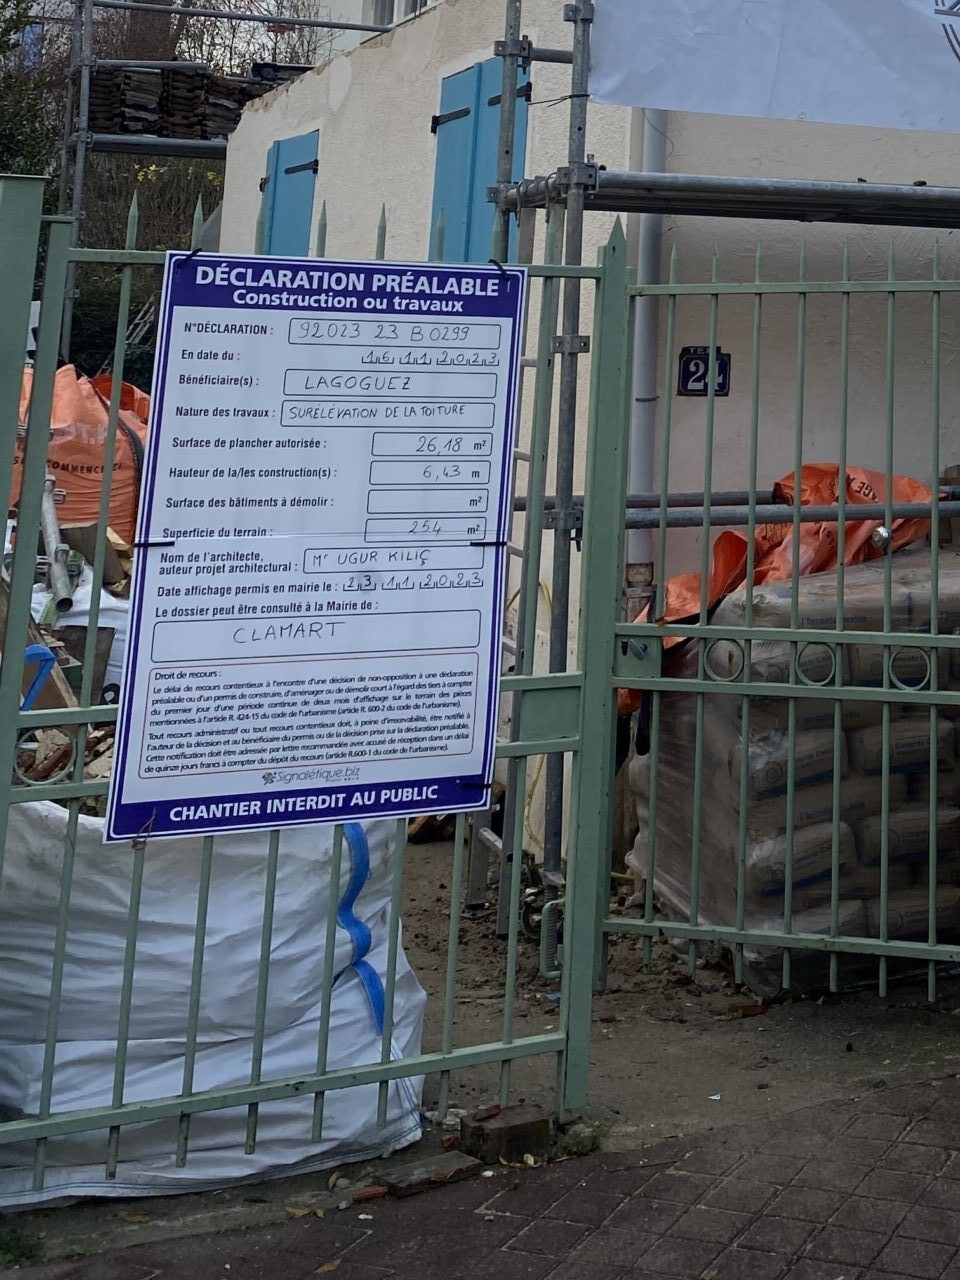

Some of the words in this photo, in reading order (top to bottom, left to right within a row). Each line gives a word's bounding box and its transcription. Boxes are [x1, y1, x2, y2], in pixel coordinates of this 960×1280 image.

[195, 266, 366, 291] DÉCLARATION
[372, 271, 499, 297] PRÉALABLE
[233, 289, 357, 310] Construction
[363, 297, 387, 311] ou
[391, 297, 463, 312] travaux
[184, 322, 267, 336] N°DÉCLARATION
[300, 322, 361, 340] 92023
[374, 325, 399, 341] 23
[411, 325, 425, 341] B
[428, 326, 470, 342] 0299
[182, 349, 196, 361] En
[199, 349, 219, 361] date
[221, 350, 234, 361] du
[179, 374, 253, 388] Bénéficiaire(s)
[687, 360, 723, 390] 24
[304, 376, 411, 391] LAGOGUEZ
[176, 406, 209, 418] Nature
[212, 407, 230, 418] des
[232, 407, 270, 418] travaux
[385, 406, 399, 418] DE
[404, 405, 417, 418] LA
[420, 403, 466, 418] TOITURE
[173, 437, 213, 450] Surface
[215, 438, 227, 449] de
[229, 437, 272, 451] plancher
[275, 438, 321, 449] autorisée
[416, 435, 463, 456] 26,18
[169, 467, 209, 479] Hauteur
[212, 468, 225, 478] de
[227, 466, 255, 479] la/les
[258, 467, 331, 481] construction(s)
[423, 464, 461, 482] 6,43
[166, 497, 205, 509] Surface
[208, 497, 226, 508] des
[229, 496, 278, 508] bâtiments
[281, 497, 287, 508] à
[290, 497, 328, 508] démolir
[163, 527, 214, 541] Superficie
[217, 527, 230, 538] du
[234, 527, 267, 538] terrain
[409, 520, 441, 536] 254
[160, 552, 184, 564] Nom
[188, 552, 201, 563] de
[204, 551, 264, 563] l'architecte,
[338, 551, 378, 566] UGUR
[389, 549, 430, 567] KILIÇ
[159, 564, 193, 576] auteur
[196, 563, 226, 577] projet
[228, 562, 292, 574] architectural
[157, 585, 182, 597] Date
[184, 583, 233, 598] affichage
[235, 582, 271, 596] permis
[273, 585, 286, 593] en
[289, 582, 320, 593] mairie
[323, 582, 332, 592] le
[156, 607, 168, 618] Le
[171, 606, 210, 617] dossier
[212, 604, 236, 617] peut
[238, 602, 258, 615] être
[261, 602, 303, 615] consulté
[305, 601, 312, 612] à
[314, 601, 324, 612] la
[327, 600, 358, 612] Mairie
[361, 600, 373, 610] de
[233, 621, 346, 644] CLAMART
[155, 672, 175, 681] Droit
[177, 671, 187, 680] de
[188, 671, 217, 679] recours
[169, 802, 261, 822] CHANTIER
[267, 795, 346, 815] INTERDIT
[350, 792, 376, 807] AU
[381, 785, 439, 804] PUBLIC
